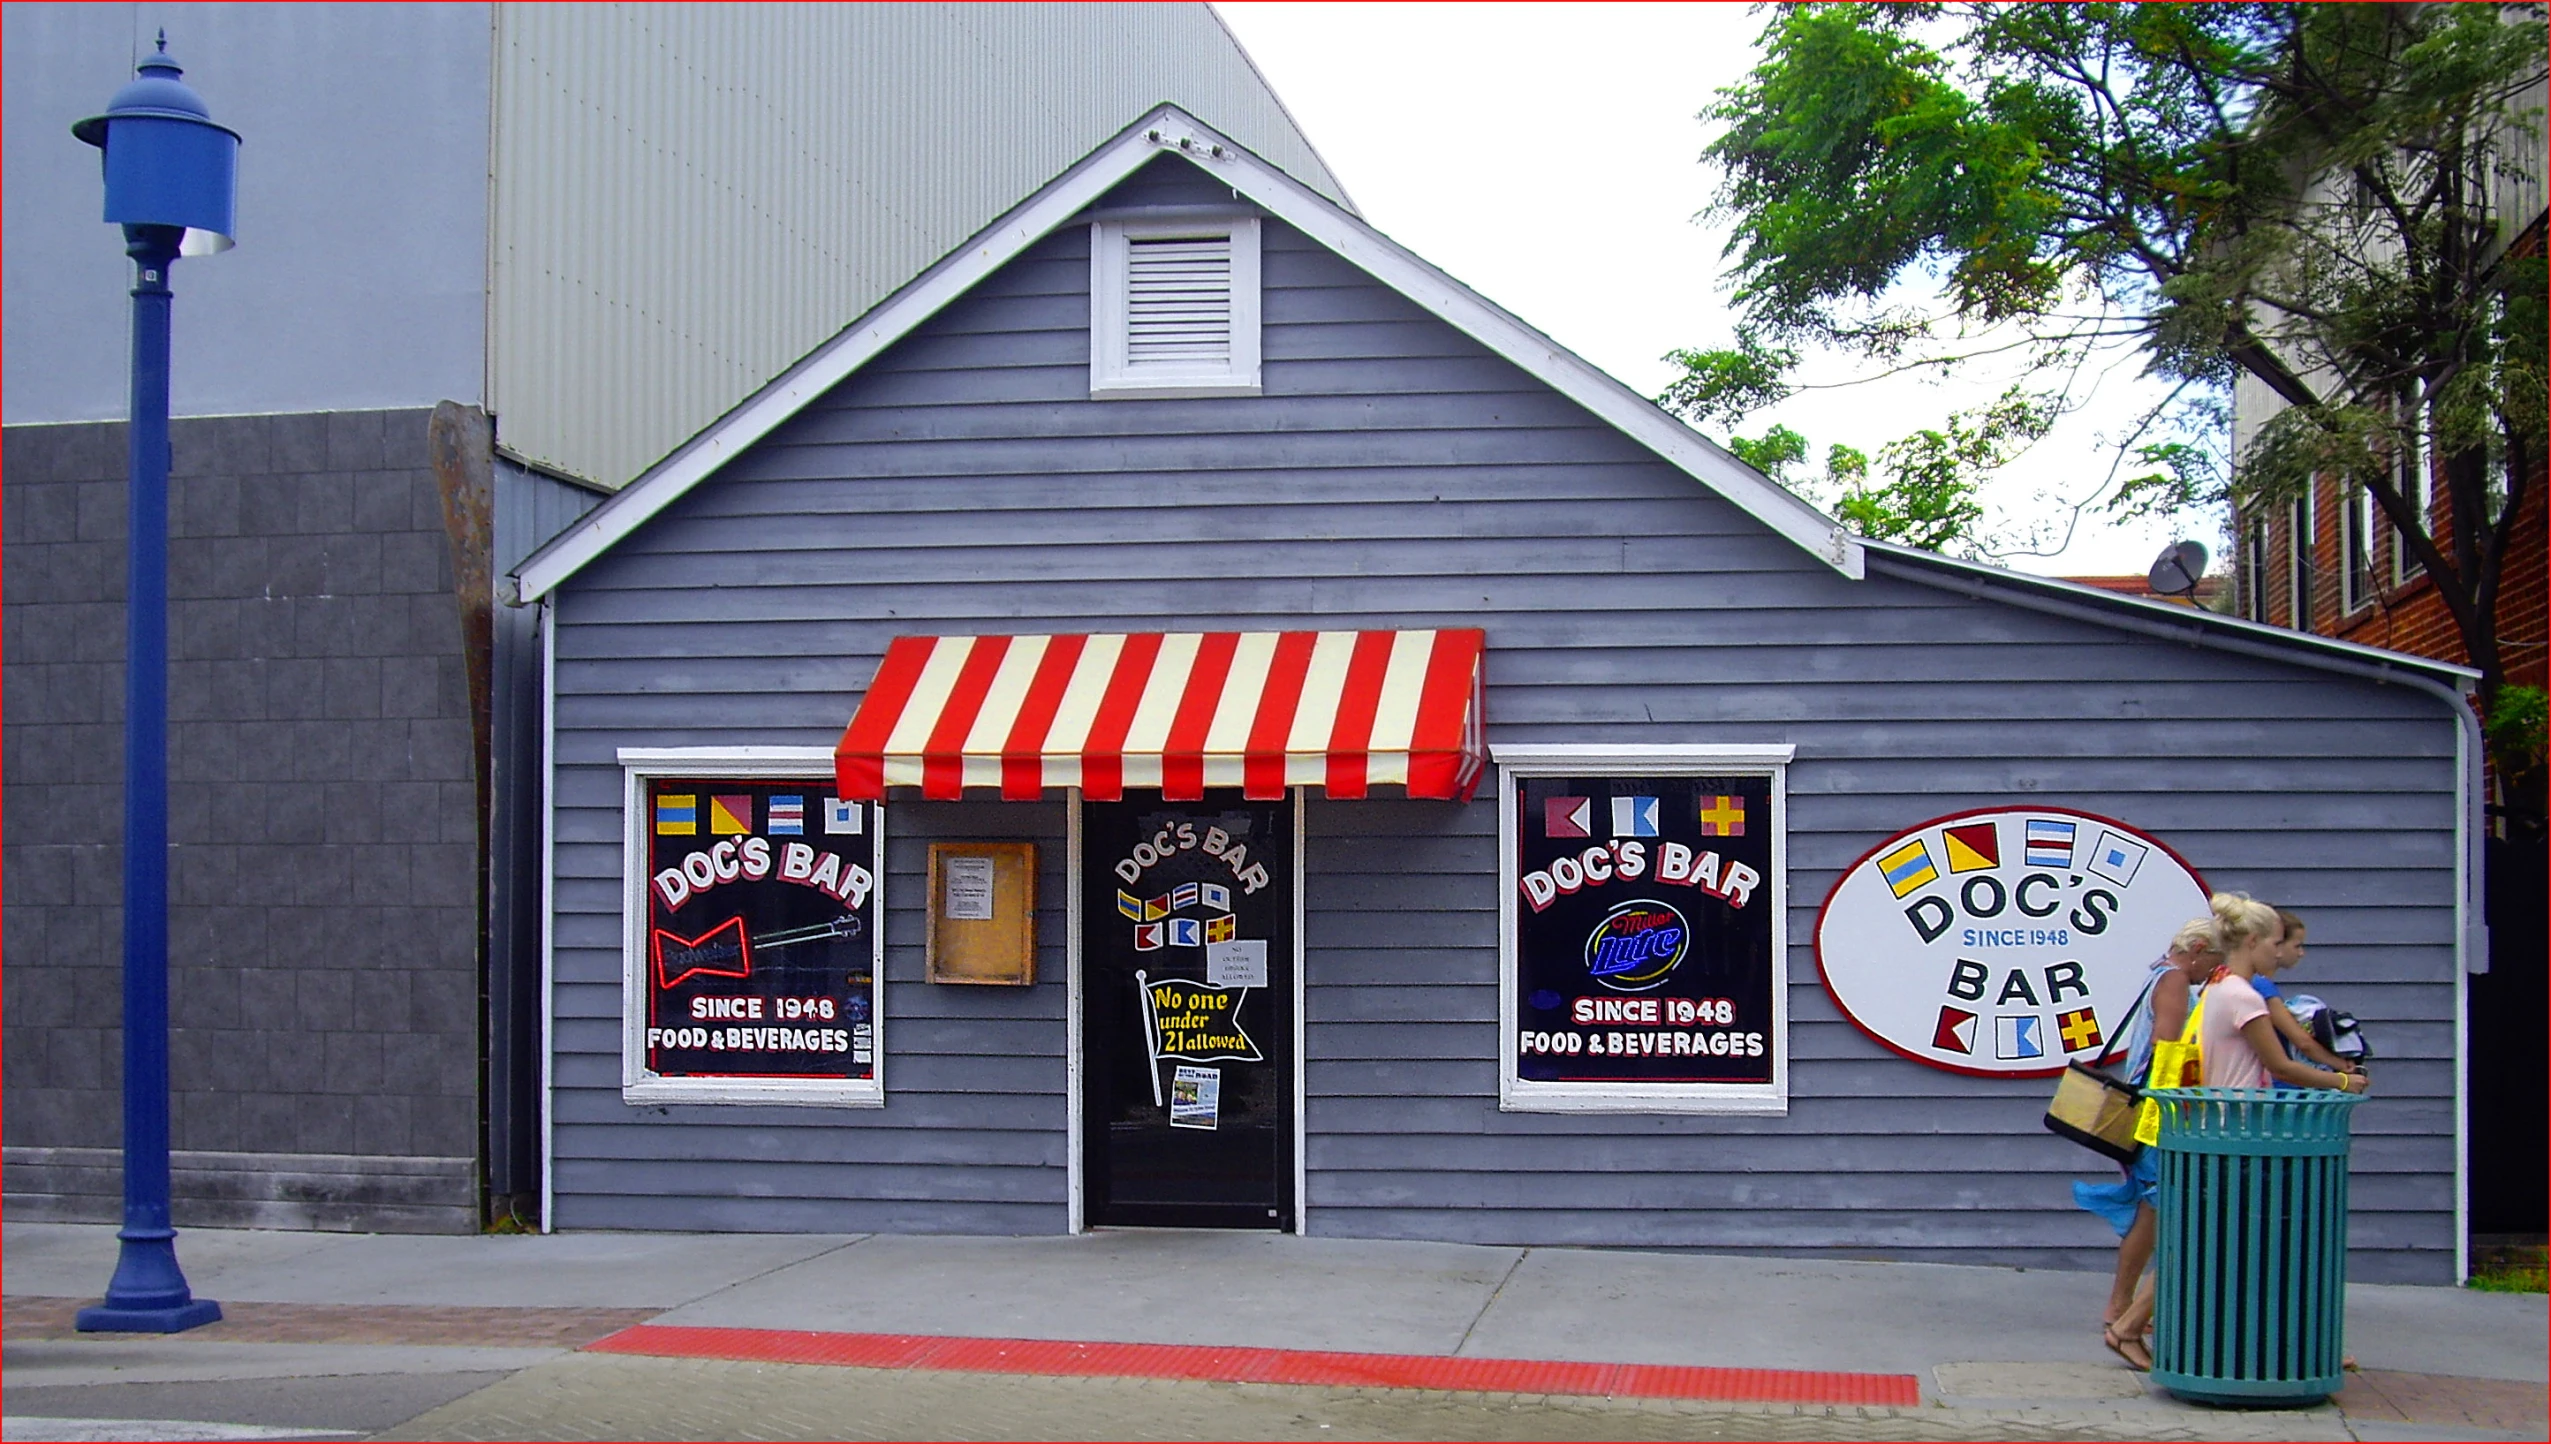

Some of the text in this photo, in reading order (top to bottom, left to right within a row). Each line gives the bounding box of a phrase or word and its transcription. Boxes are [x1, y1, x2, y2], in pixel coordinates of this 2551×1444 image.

[1115, 821, 1269, 895] DOC'S BAR
[654, 834, 771, 911] DOC'S
[777, 842, 873, 910] BAR
[1521, 840, 1760, 913] DOC'S BAR
[1903, 872, 2120, 945] DOC'S
[1612, 912, 1676, 934] Miller
[1963, 929, 2069, 947] SINCE 1948
[1590, 929, 1681, 974] Lite
[1947, 957, 2090, 1006] BAR
[691, 997, 835, 1019] SINCE 1948
[1155, 986, 1228, 1010] No one
[1573, 998, 1734, 1023] SINCE 1948
[1160, 1010, 1210, 1030] under
[648, 1028, 708, 1050] FOOD
[727, 1028, 848, 1052] BEVERAGES
[1521, 1031, 1582, 1054] FOOD
[1607, 1032, 1764, 1056] BEVERAGES
